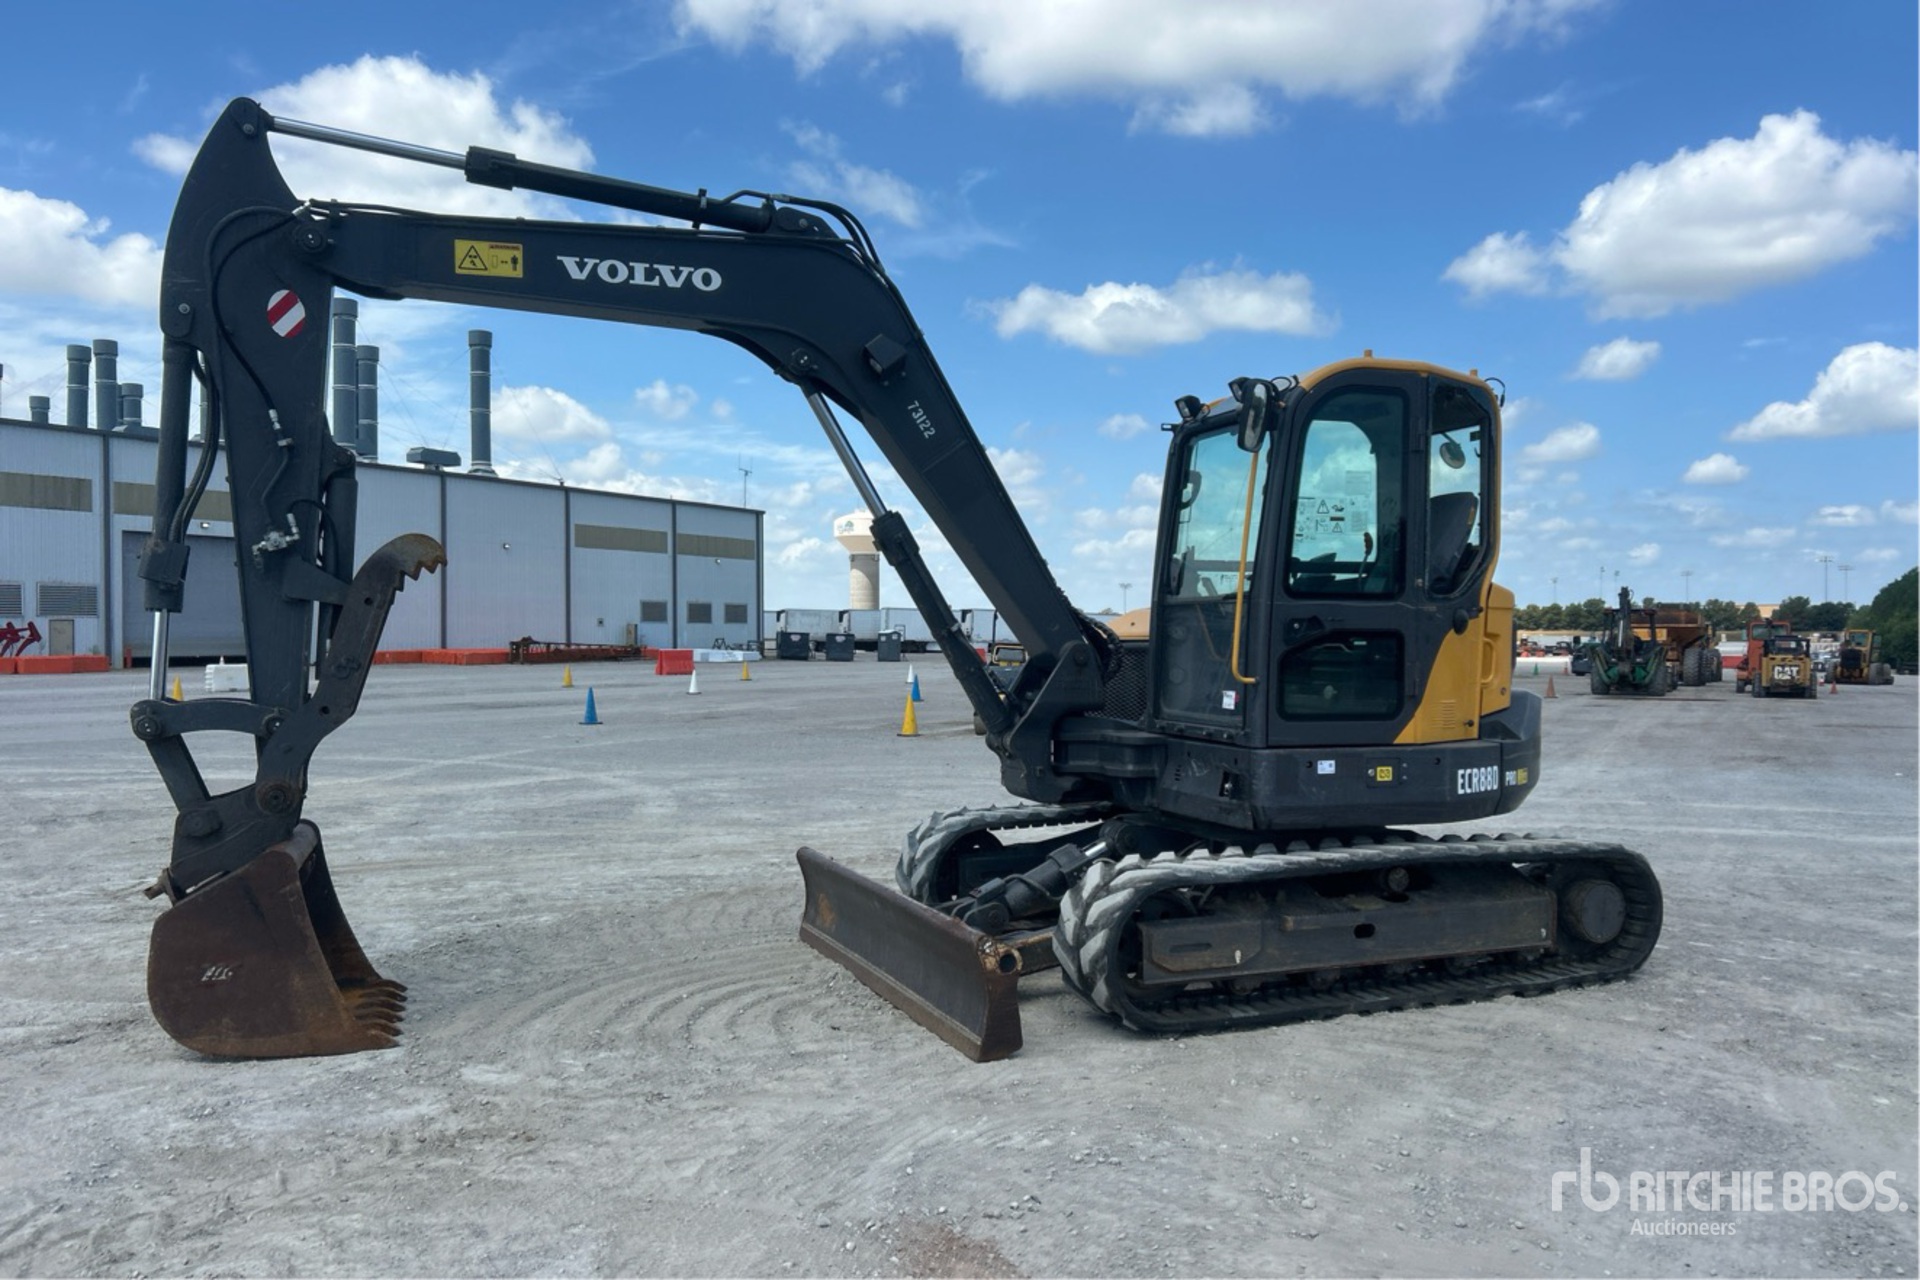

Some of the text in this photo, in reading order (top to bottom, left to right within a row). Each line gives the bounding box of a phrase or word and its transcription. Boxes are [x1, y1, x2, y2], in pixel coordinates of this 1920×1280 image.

[557, 255, 722, 292] VOLVO
[907, 400, 936, 439] 73122
[1774, 665, 1799, 680] CAT
[1457, 765, 1499, 795] ECR88D
